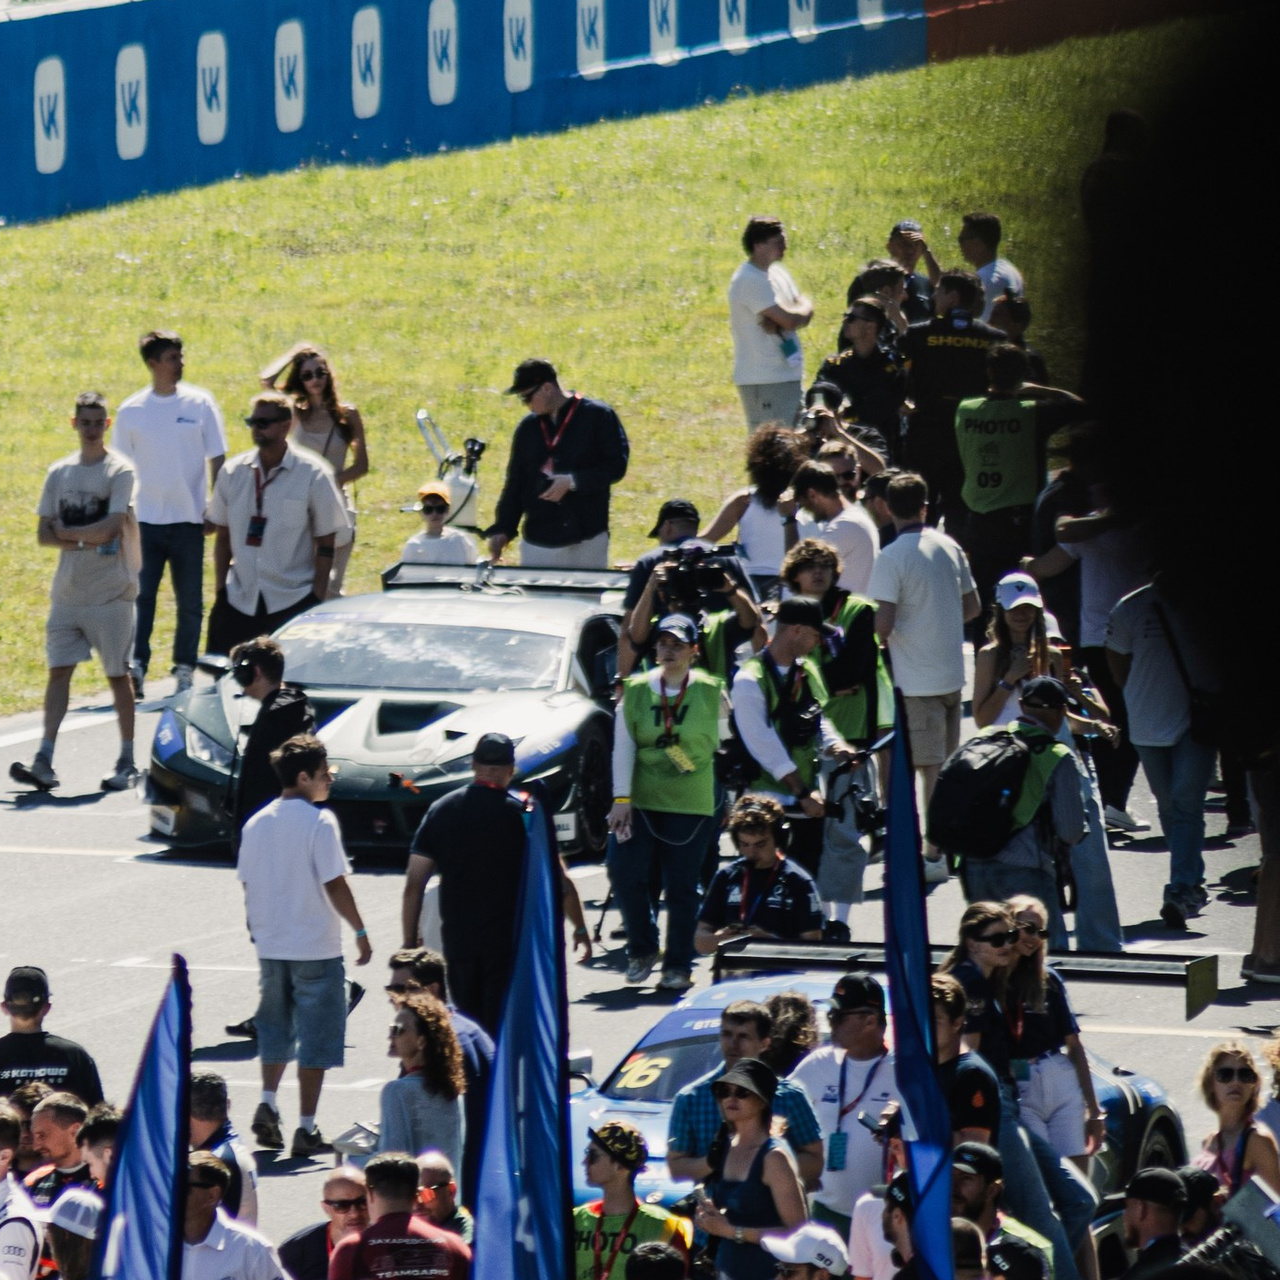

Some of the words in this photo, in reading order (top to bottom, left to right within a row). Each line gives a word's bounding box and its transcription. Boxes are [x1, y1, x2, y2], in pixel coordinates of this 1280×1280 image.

[510, 17, 527, 62] VK
[581, 5, 599, 50] VK
[357, 41, 375, 87] VK
[433, 29, 451, 74] VK
[202, 67, 221, 113] VK
[280, 55, 299, 101] VK
[40, 92, 60, 141] VK
[121, 79, 141, 128] VK
[963, 417, 1021, 436] PHOTO
[976, 471, 1003, 489] 09
[615, 1056, 672, 1089] 16
[575, 1229, 638, 1255] HOTO
[814, 1252, 834, 1267] 90
